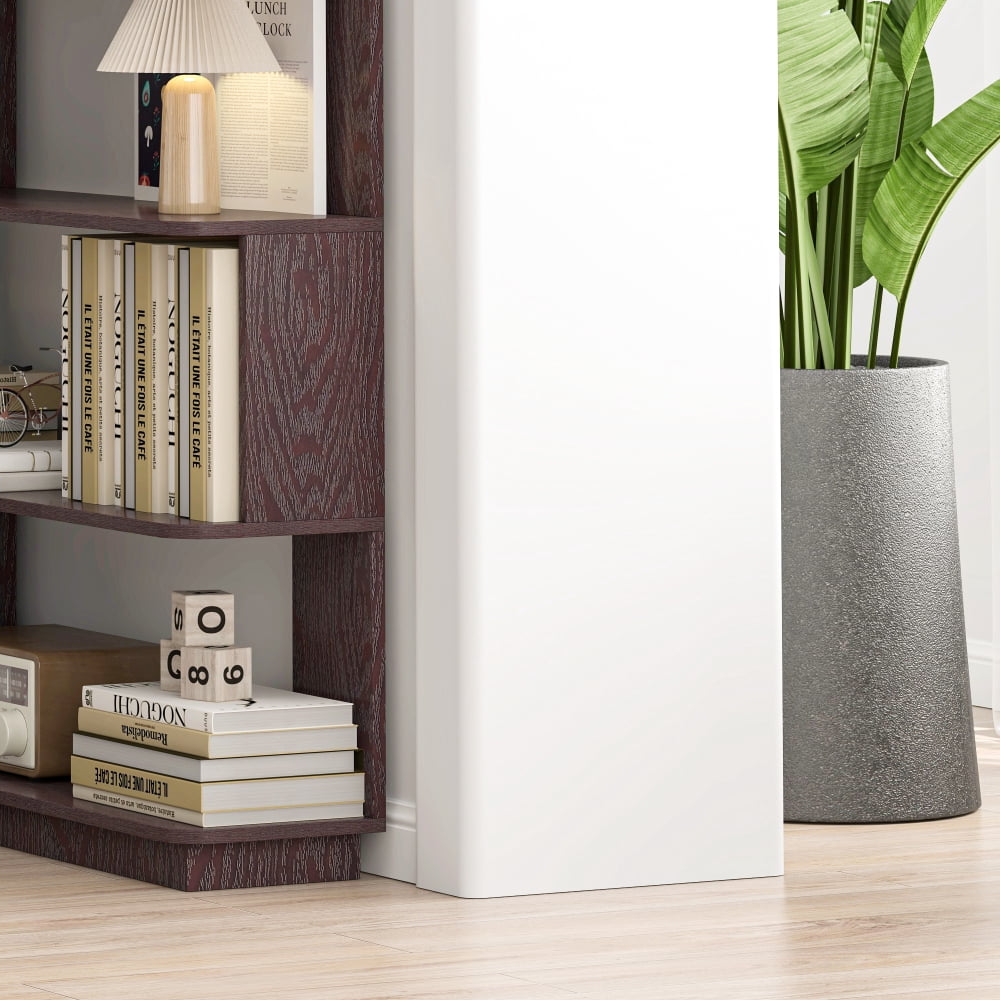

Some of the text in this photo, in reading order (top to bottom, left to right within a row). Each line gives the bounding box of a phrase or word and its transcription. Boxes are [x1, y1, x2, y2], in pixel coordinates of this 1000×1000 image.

[257, 22, 292, 37] LOCK
[84, 304, 93, 453] IL ÉTAIT UNE FOIS LE CAFÉ
[137, 310, 146, 461] IL ÉTAIT UNE FOIS LE CAFÉ
[192, 315, 202, 468] IL ÉTAIT UNE FOIS LE CAFÉ
[113, 694, 187, 727] NOGUCHI
[121, 724, 168, 746] Remodelista
